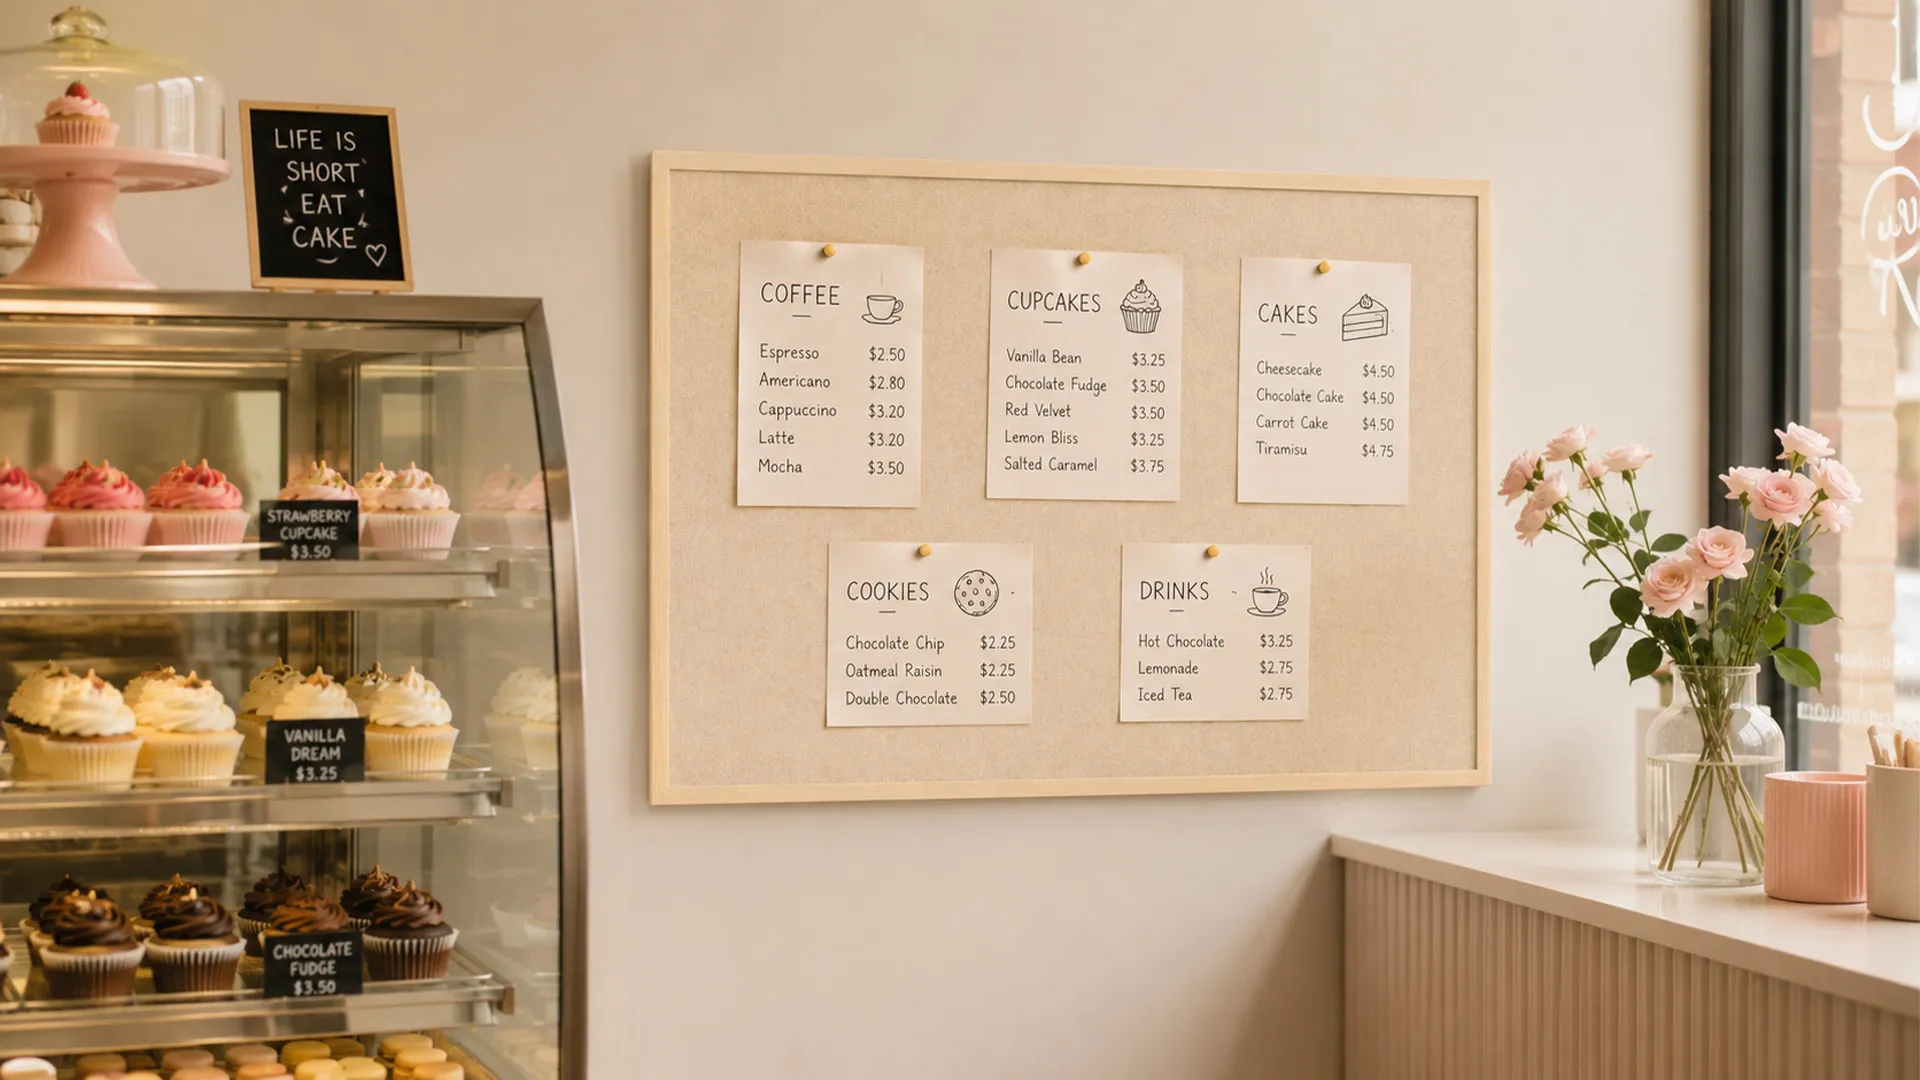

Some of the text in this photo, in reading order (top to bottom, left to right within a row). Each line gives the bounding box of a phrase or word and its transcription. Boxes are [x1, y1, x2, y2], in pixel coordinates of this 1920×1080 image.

[274, 128, 356, 151] LIFE IS
[287, 161, 360, 183] SHORT
[301, 193, 347, 215] EAT
[292, 225, 357, 248] CAKE
[761, 282, 840, 306] COFFEE
[1007, 290, 1101, 313] CUPCAKES
[1258, 303, 1318, 324] CAKES
[759, 343, 906, 363] Espresso $2.50
[1006, 349, 1166, 367] Vanilla Bean $3.25
[1256, 360, 1395, 379] Cheesecake $4.50
[759, 372, 906, 390] Americano $2.80
[1005, 375, 1166, 397] Chocolate Fudge $3.50
[1256, 387, 1395, 405] Chocolate Cake $4.50
[759, 400, 905, 420] Cappuccino $3.20
[1005, 402, 1165, 420] Red Velvet $3.50
[1256, 414, 1395, 432] Carrot Cake $4.50
[759, 430, 905, 447] Latte $3.20
[1005, 429, 1165, 447] Lemon Bliss $3.25
[1256, 440, 1394, 459] Tiramisu $4.75
[758, 459, 905, 476] Mocha $3.50
[1004, 456, 1164, 474] Salted Caramel $3.75
[267, 509, 352, 523] STRAWBERRY
[280, 527, 338, 540] CUPCAKE
[291, 544, 331, 559] $3.50
[846, 581, 930, 601] COOKIES
[1140, 580, 1210, 601] DRINKS
[845, 635, 1016, 654] Chocolate Chip $2.25
[1139, 634, 1293, 648] Hot Chocolate $3.25
[845, 662, 1016, 678] Oatmeal Raisin $2.25
[1138, 660, 1293, 675] Lemonade $2.75
[845, 690, 1016, 706] Double Chocolate $2.50
[1138, 686, 1293, 701] Iced Tea $2.75
[284, 728, 346, 743] VANILLA
[291, 747, 341, 762] DREAM
[296, 766, 338, 782] $3.25
[272, 941, 353, 960] CHOCOLATE
[290, 960, 337, 977] FUDGE
[293, 980, 337, 996] $3.50
